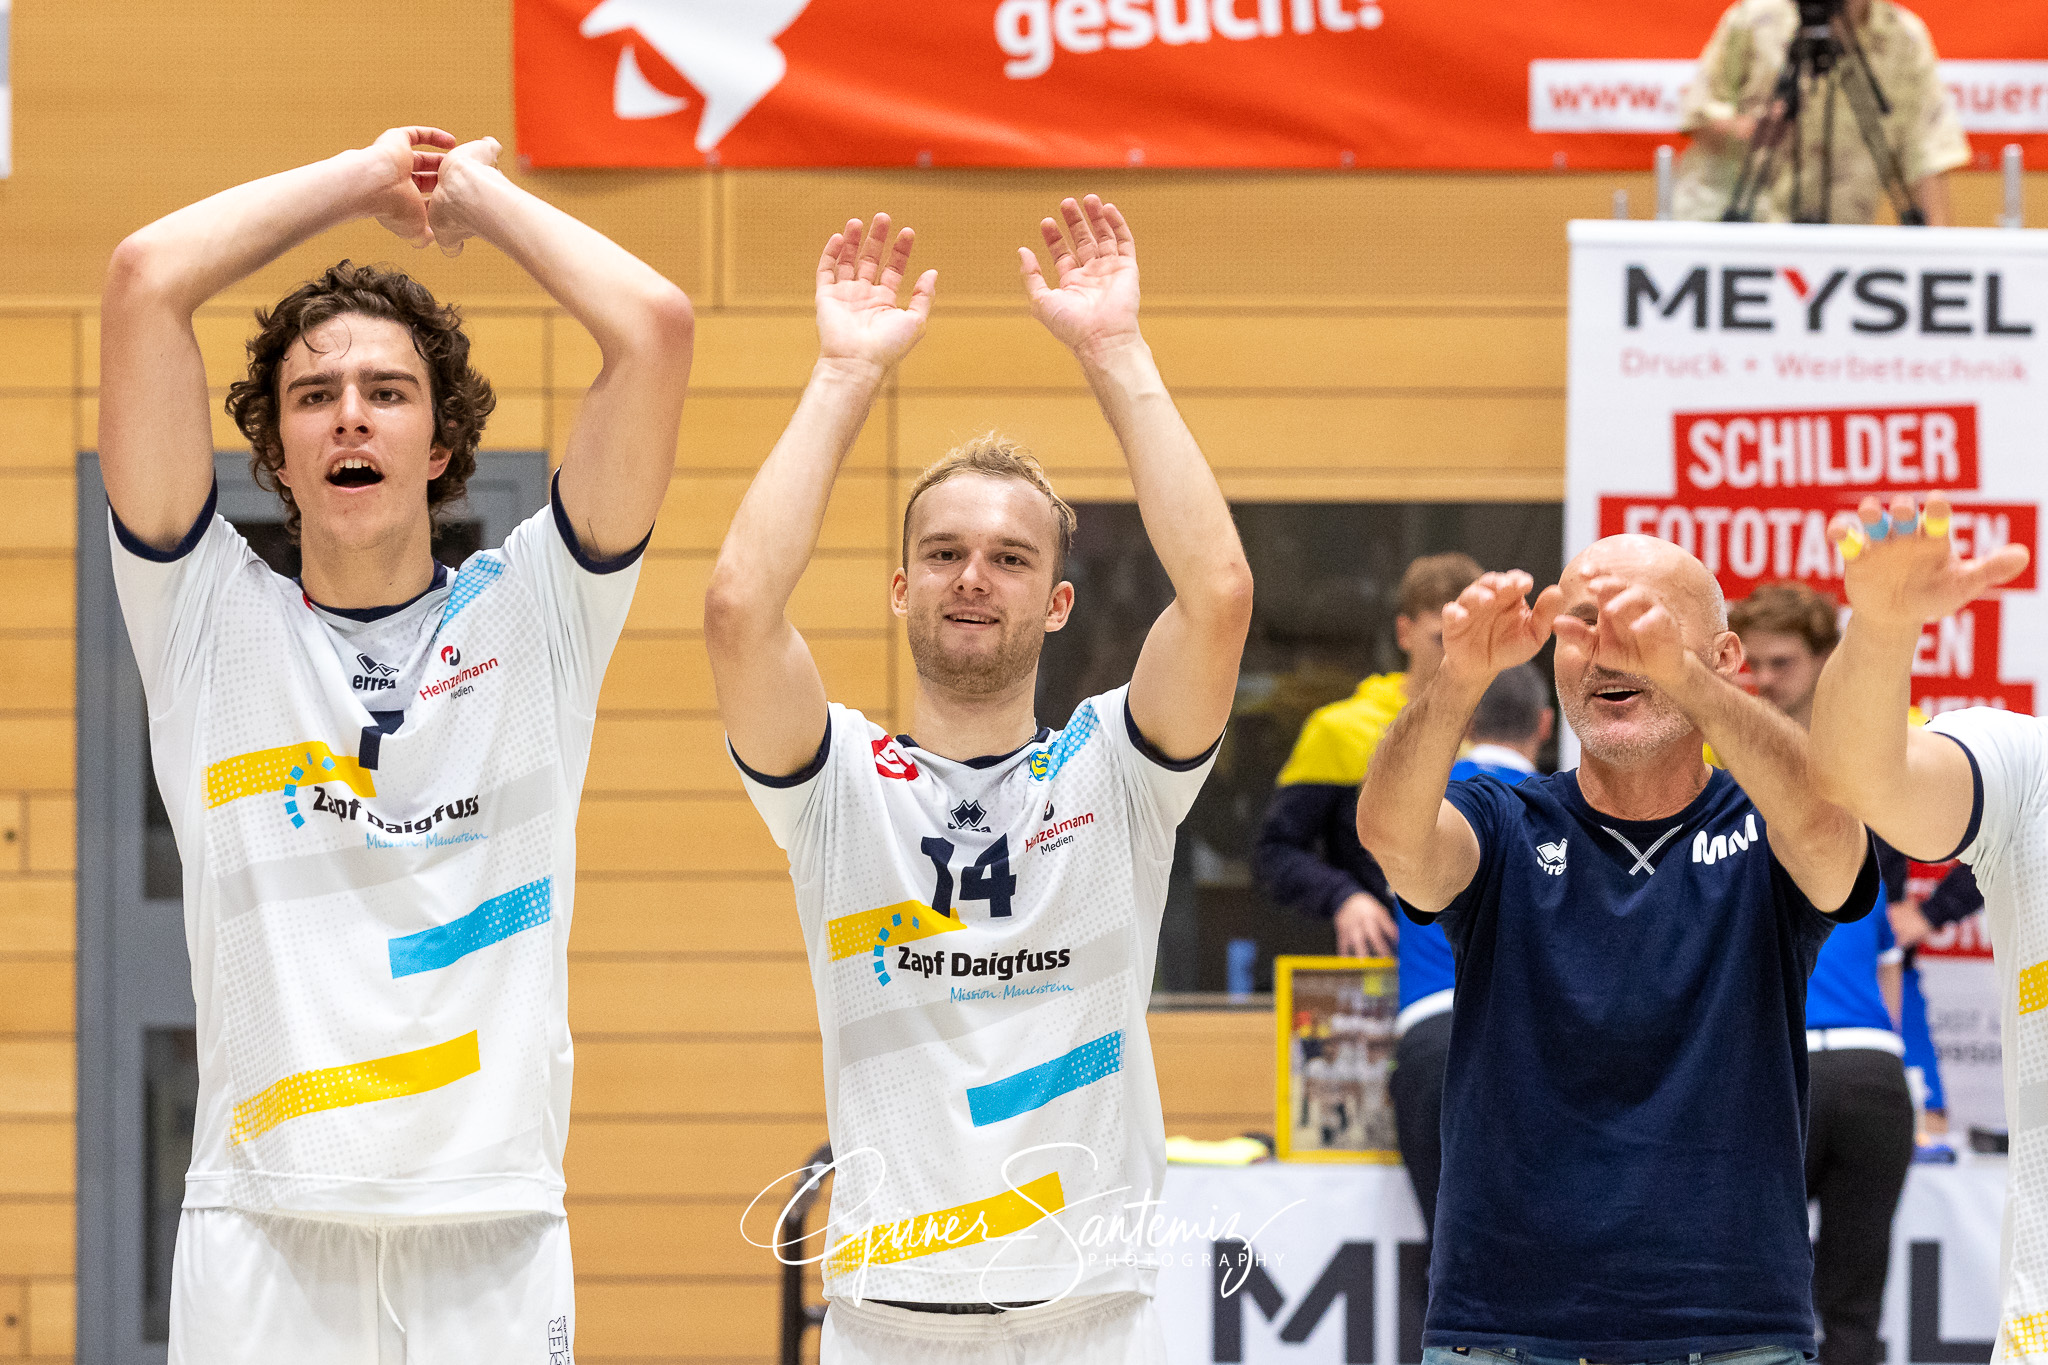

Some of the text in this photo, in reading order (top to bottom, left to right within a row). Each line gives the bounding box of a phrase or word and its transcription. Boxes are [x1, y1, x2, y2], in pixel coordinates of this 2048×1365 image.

[994, 0, 1384, 80] gesuc
[1548, 82, 1692, 112] www.
[1624, 265, 2033, 337] MEYSEL
[1621, 348, 2029, 385] Druck Werbetechnik
[1687, 412, 1960, 490] SCHILDER
[419, 657, 499, 701] Heinzelmann
[312, 785, 362, 823] Zapf
[1040, 834, 1074, 856] Medien
[920, 833, 1017, 918] 14
[898, 945, 1071, 981] Zapf Daigfuss
[950, 980, 1075, 1004] Mission: Mauerstein
